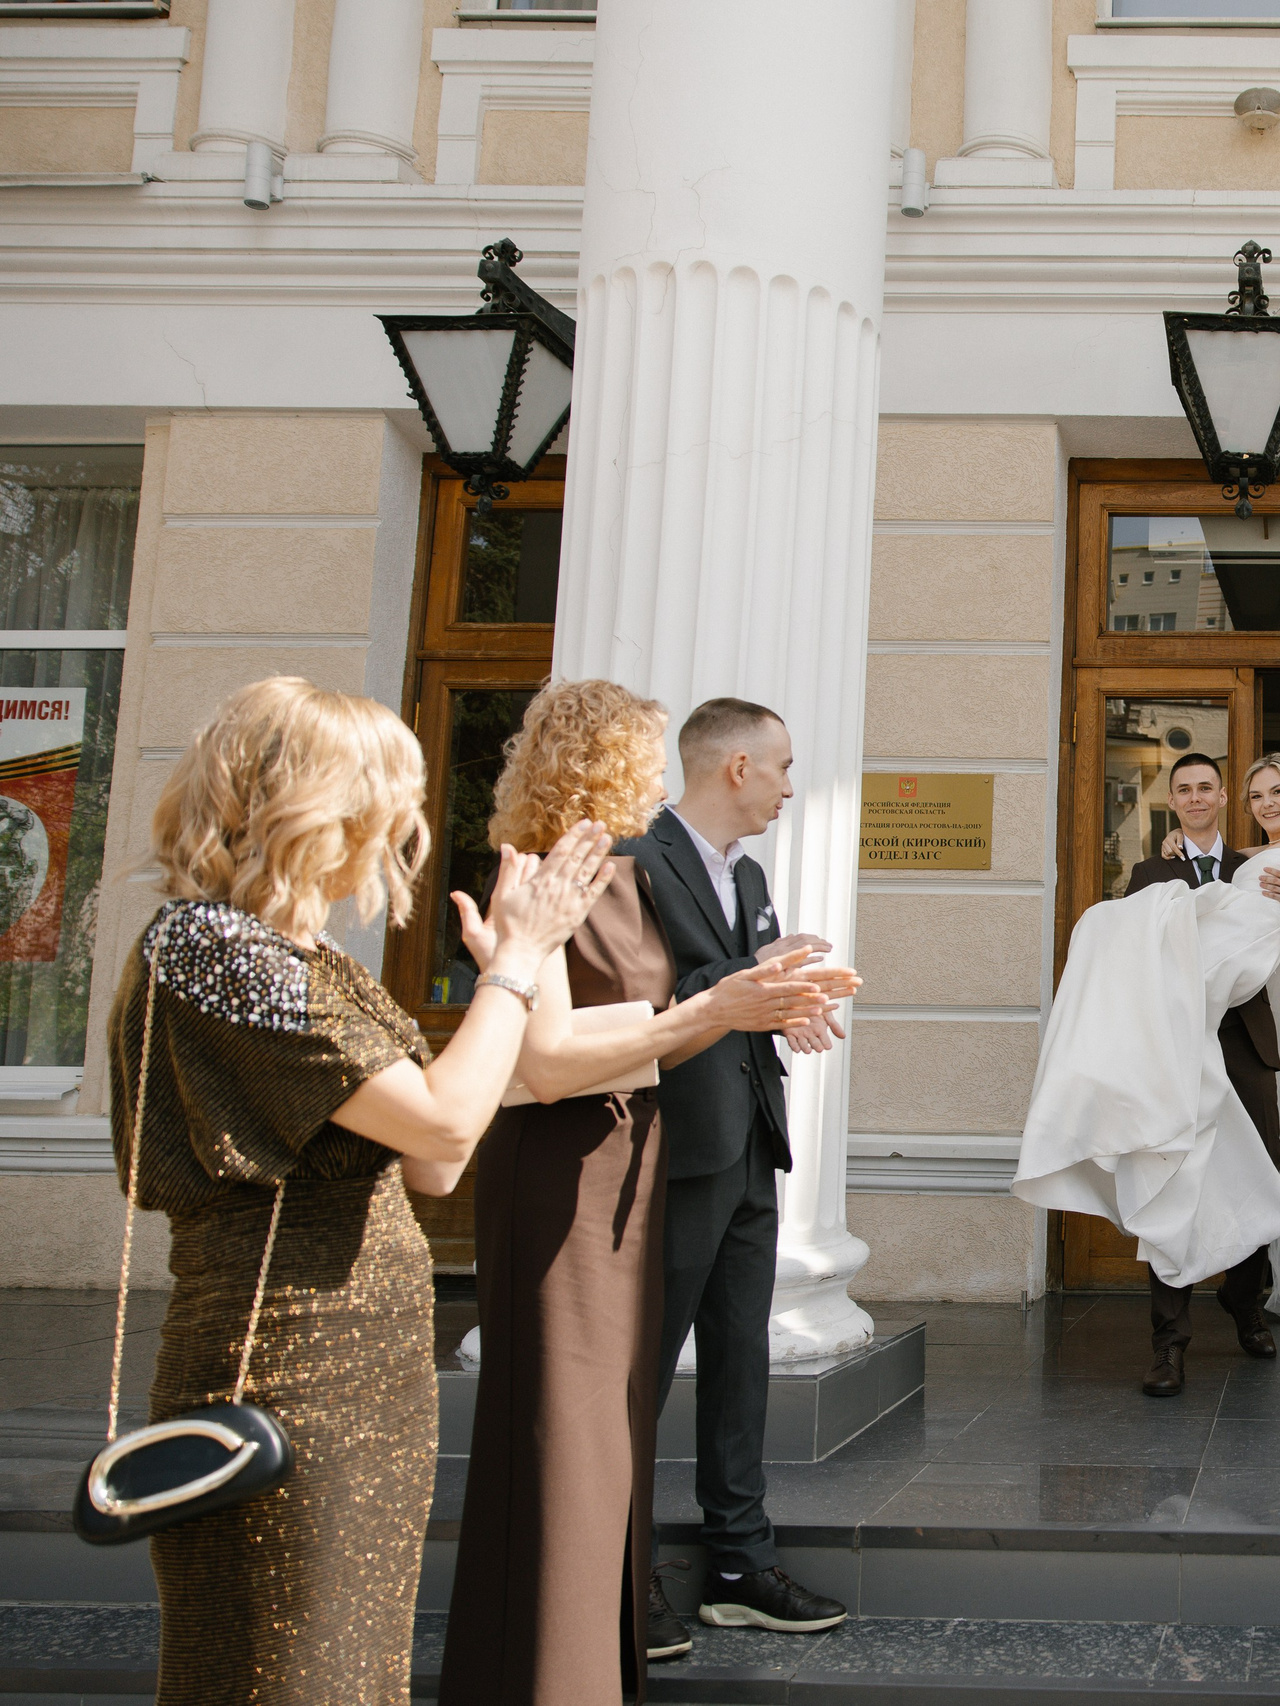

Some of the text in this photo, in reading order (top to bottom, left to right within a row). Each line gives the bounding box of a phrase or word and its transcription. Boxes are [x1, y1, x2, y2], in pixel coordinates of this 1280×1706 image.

[0, 699, 70, 723] ИМСЯ!
[902, 837, 986, 849] (КИРОВСКИЙ)
[869, 851, 942, 861] ОТДЕЛ ЗАГС
